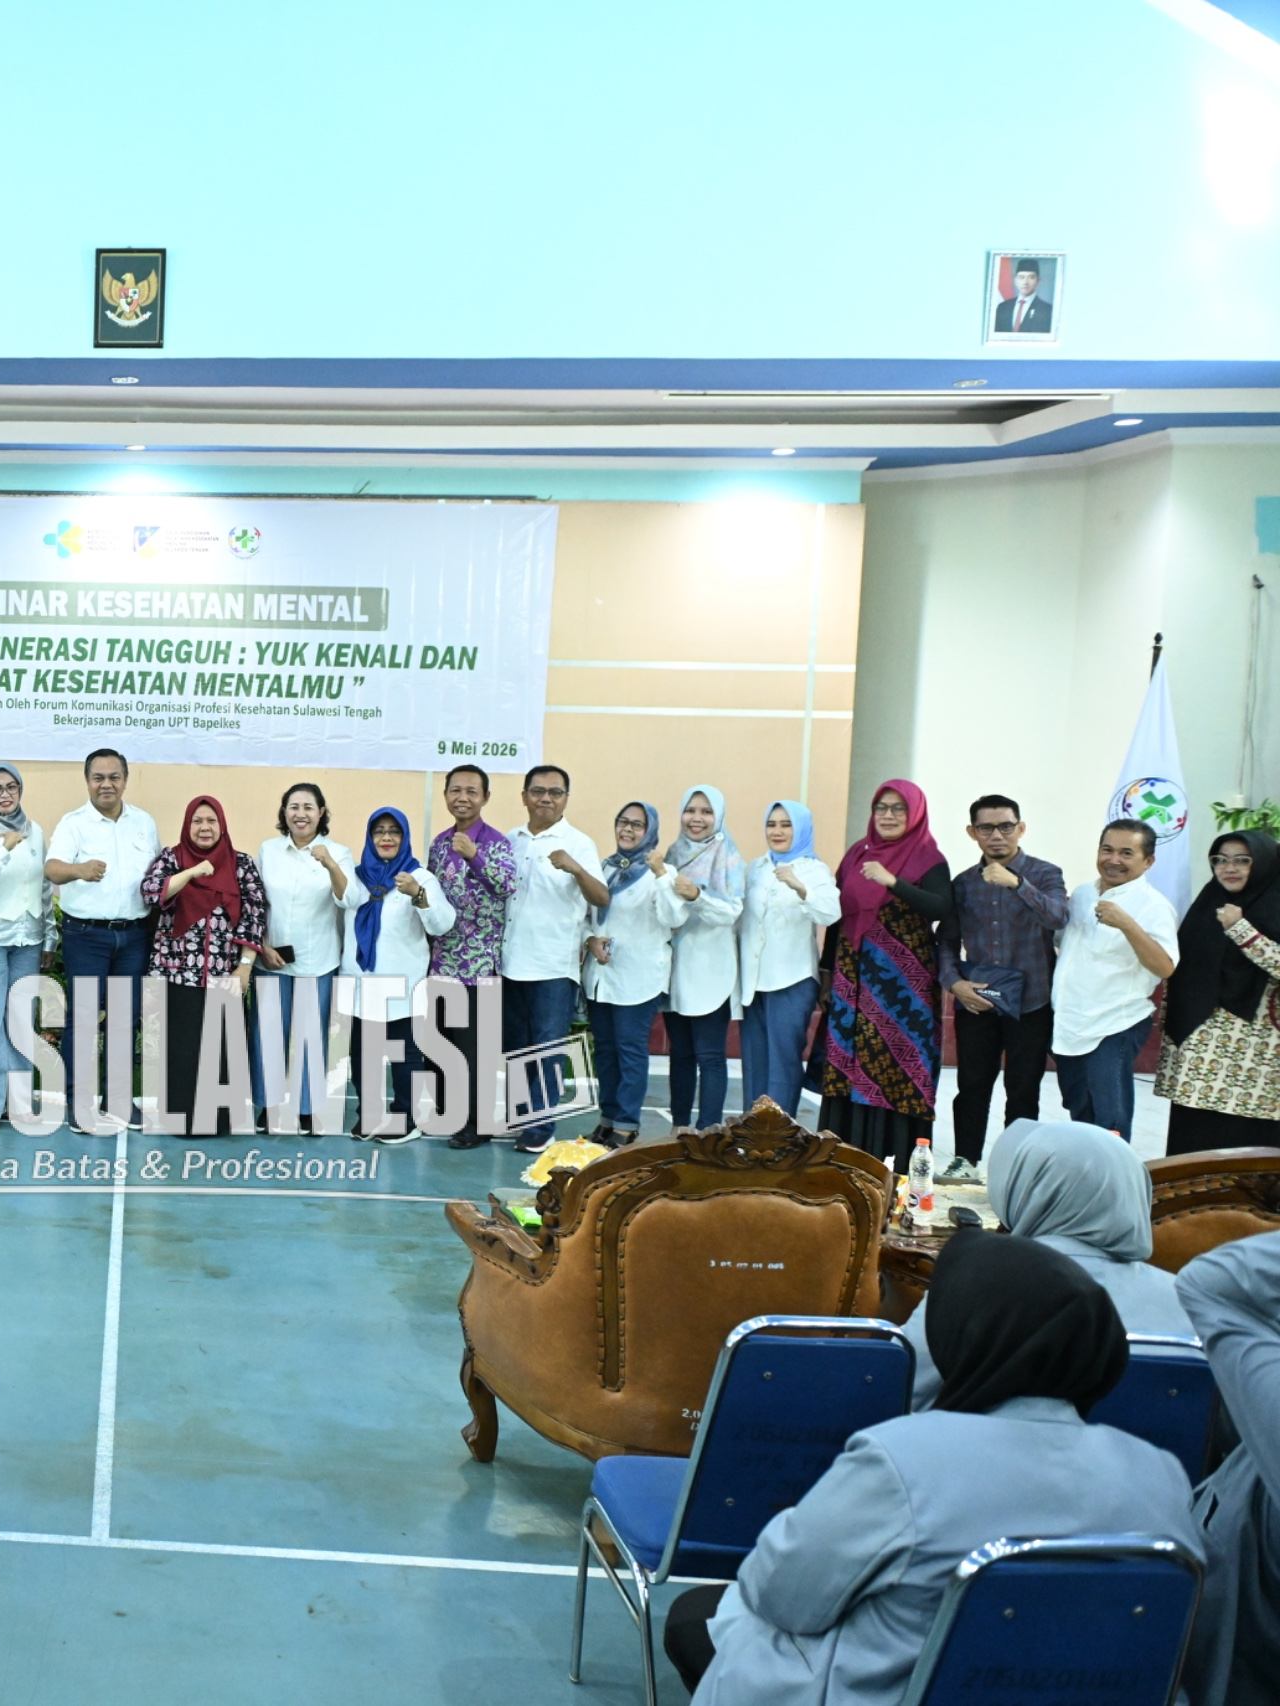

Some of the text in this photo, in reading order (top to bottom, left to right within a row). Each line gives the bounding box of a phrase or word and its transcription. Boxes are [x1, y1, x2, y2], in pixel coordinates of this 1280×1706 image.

[76, 589, 245, 621] KESEHATAN
[252, 593, 369, 623] MENTAL
[106, 638, 232, 665] TANGGUH
[255, 641, 309, 667] YUK
[315, 642, 413, 669] KENALI
[420, 645, 478, 671] DAN
[32, 669, 187, 696] KESEHATAN
[193, 671, 344, 700] MENTALMU
[6, 697, 31, 710] Oleh
[34, 698, 68, 711] Forum
[71, 699, 133, 713] Komunikasi
[135, 700, 192, 715] Organisasi
[194, 702, 231, 715] Profesi
[234, 703, 290, 716] Kesehatan
[293, 704, 341, 718] Sulawesi
[345, 706, 383, 720] Tengah
[53, 714, 241, 732] Bekerjasama Dengan UPT Bapelkes
[438, 741, 518, 757] 9 Mei 2026
